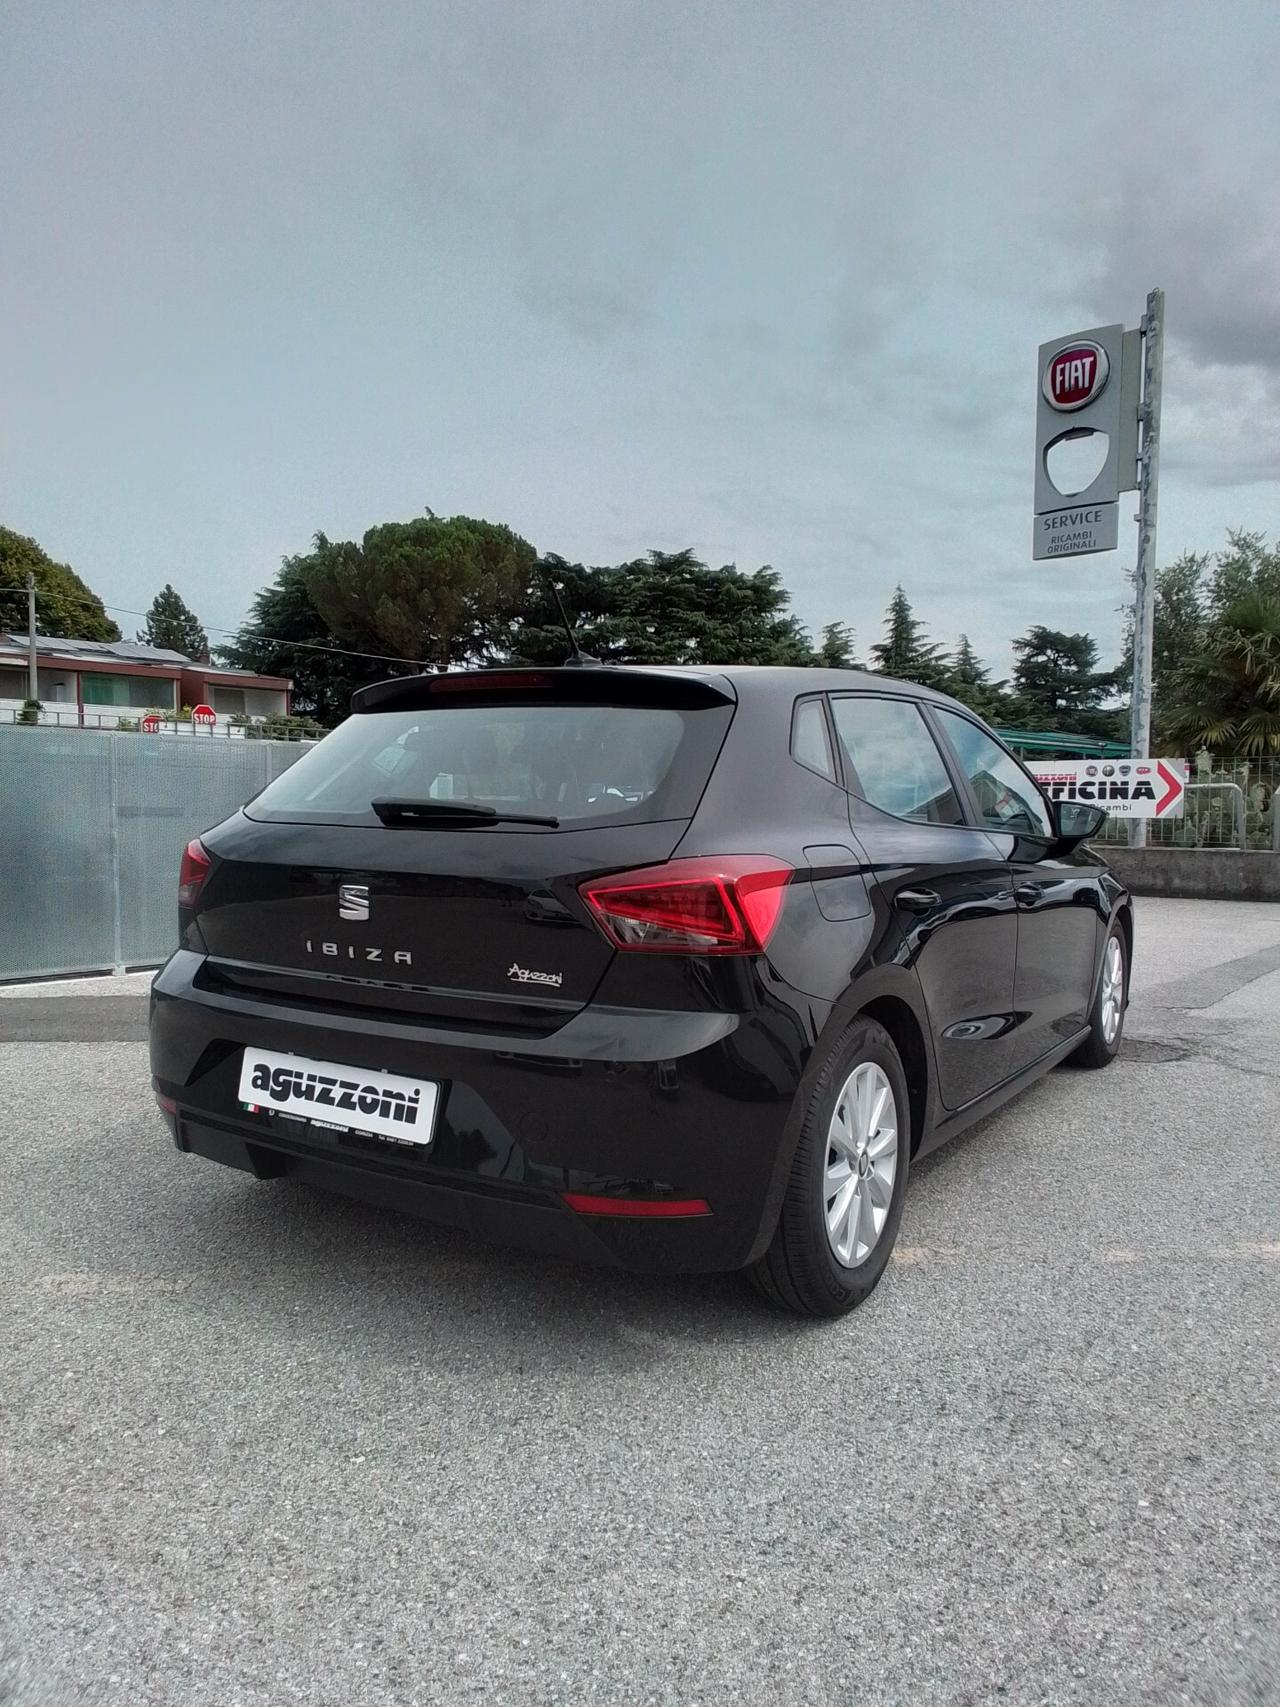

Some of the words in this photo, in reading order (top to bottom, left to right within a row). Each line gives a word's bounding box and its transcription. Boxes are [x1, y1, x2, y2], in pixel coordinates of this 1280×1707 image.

[1055, 357, 1094, 395] FIAT
[1044, 510, 1102, 530] SERVICE
[1047, 540, 1096, 553] ORIGINALI
[1051, 531, 1092, 544] RICAMBI
[193, 714, 215, 724] STOP
[306, 940, 412, 965] IBIZA
[251, 1063, 421, 1125] aguzzoni
